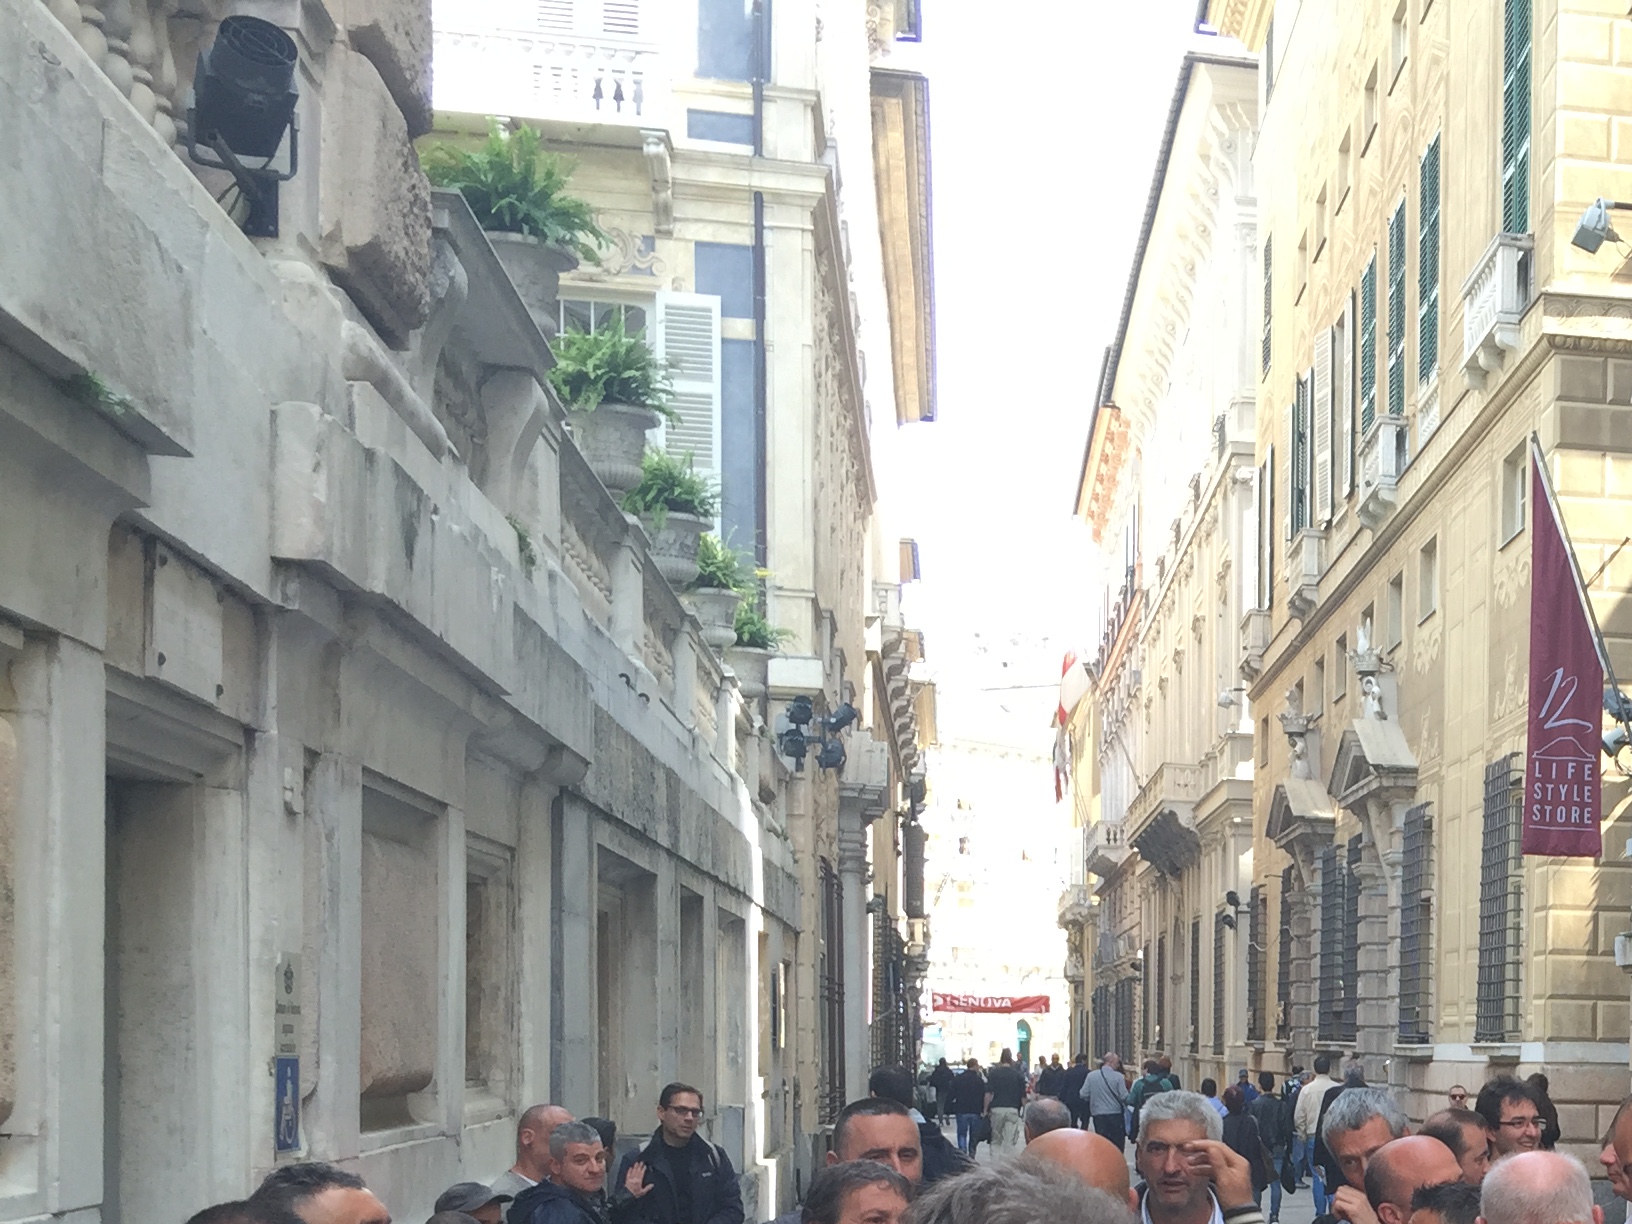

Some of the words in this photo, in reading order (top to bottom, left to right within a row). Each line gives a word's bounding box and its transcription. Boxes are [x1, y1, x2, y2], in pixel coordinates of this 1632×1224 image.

[1542, 667, 1593, 734] 12
[1534, 761, 1592, 781] LIFE
[1533, 782, 1592, 803] STYLE
[1532, 804, 1592, 824] STORE
